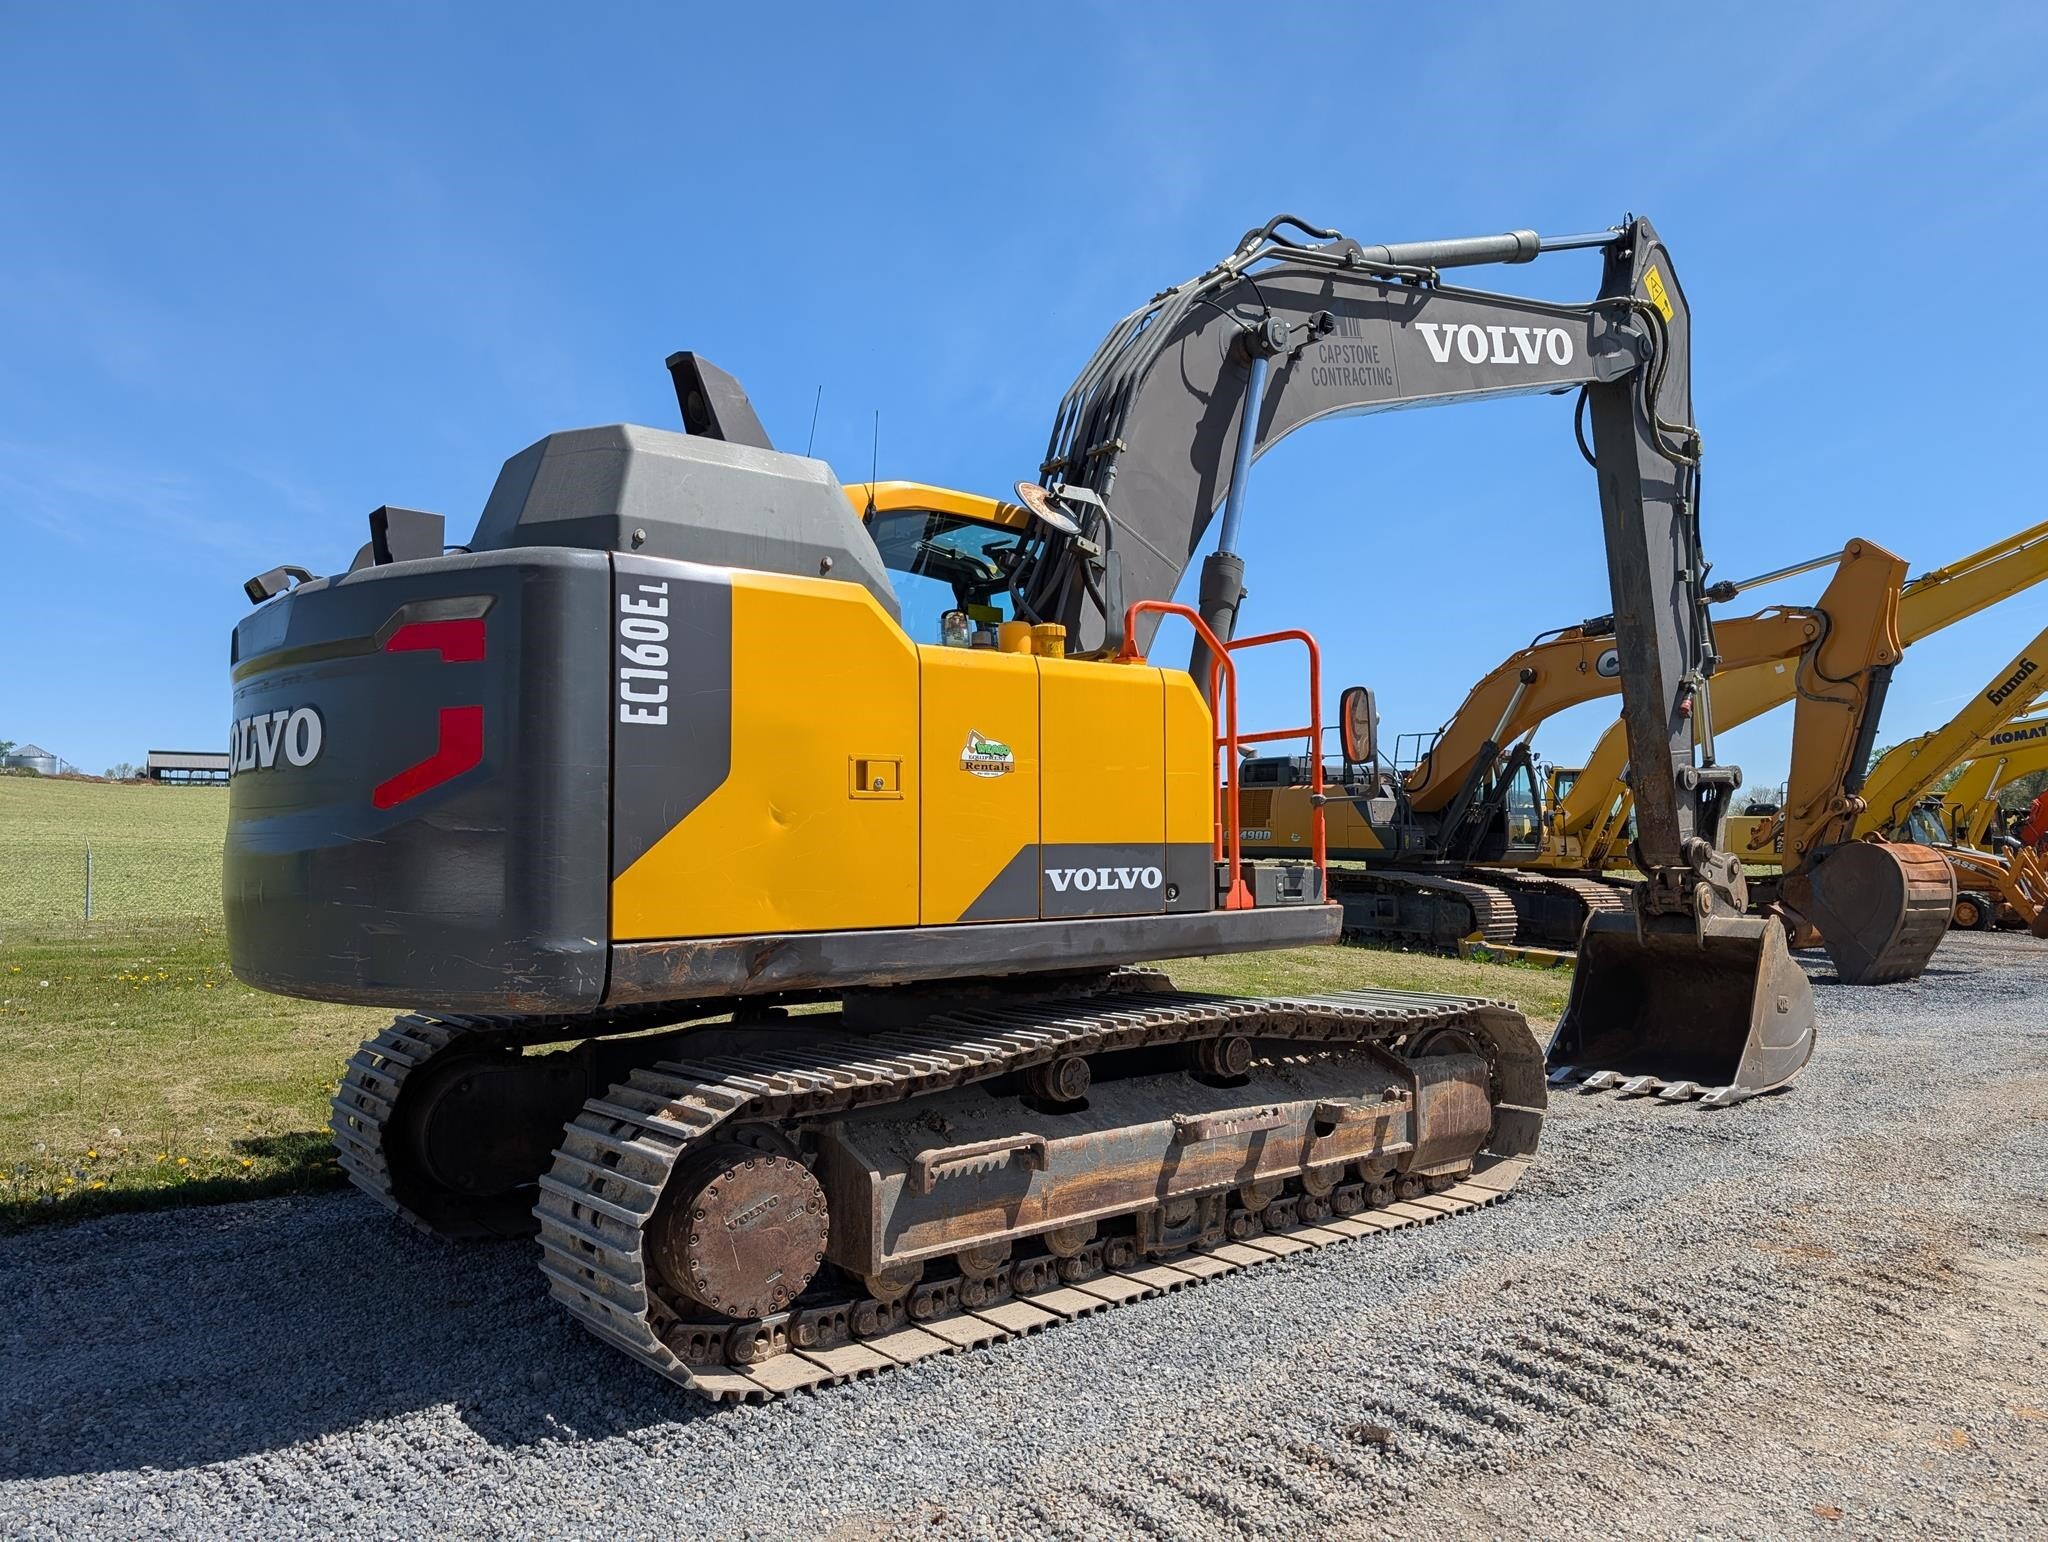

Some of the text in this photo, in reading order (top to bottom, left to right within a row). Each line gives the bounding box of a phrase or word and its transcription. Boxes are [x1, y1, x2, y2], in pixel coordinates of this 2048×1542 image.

[1318, 343, 1381, 364] CAPSTONE
[1414, 322, 1574, 366] VOLVO
[1311, 367, 1393, 386] CONTRACTING
[229, 707, 322, 775] OLVO
[1990, 722, 2048, 746] KOMAT
[965, 761, 1010, 772] Rentals
[1223, 829, 1272, 841] C490D
[1946, 855, 1978, 872] CASE
[1045, 866, 1163, 892] VOLVO
